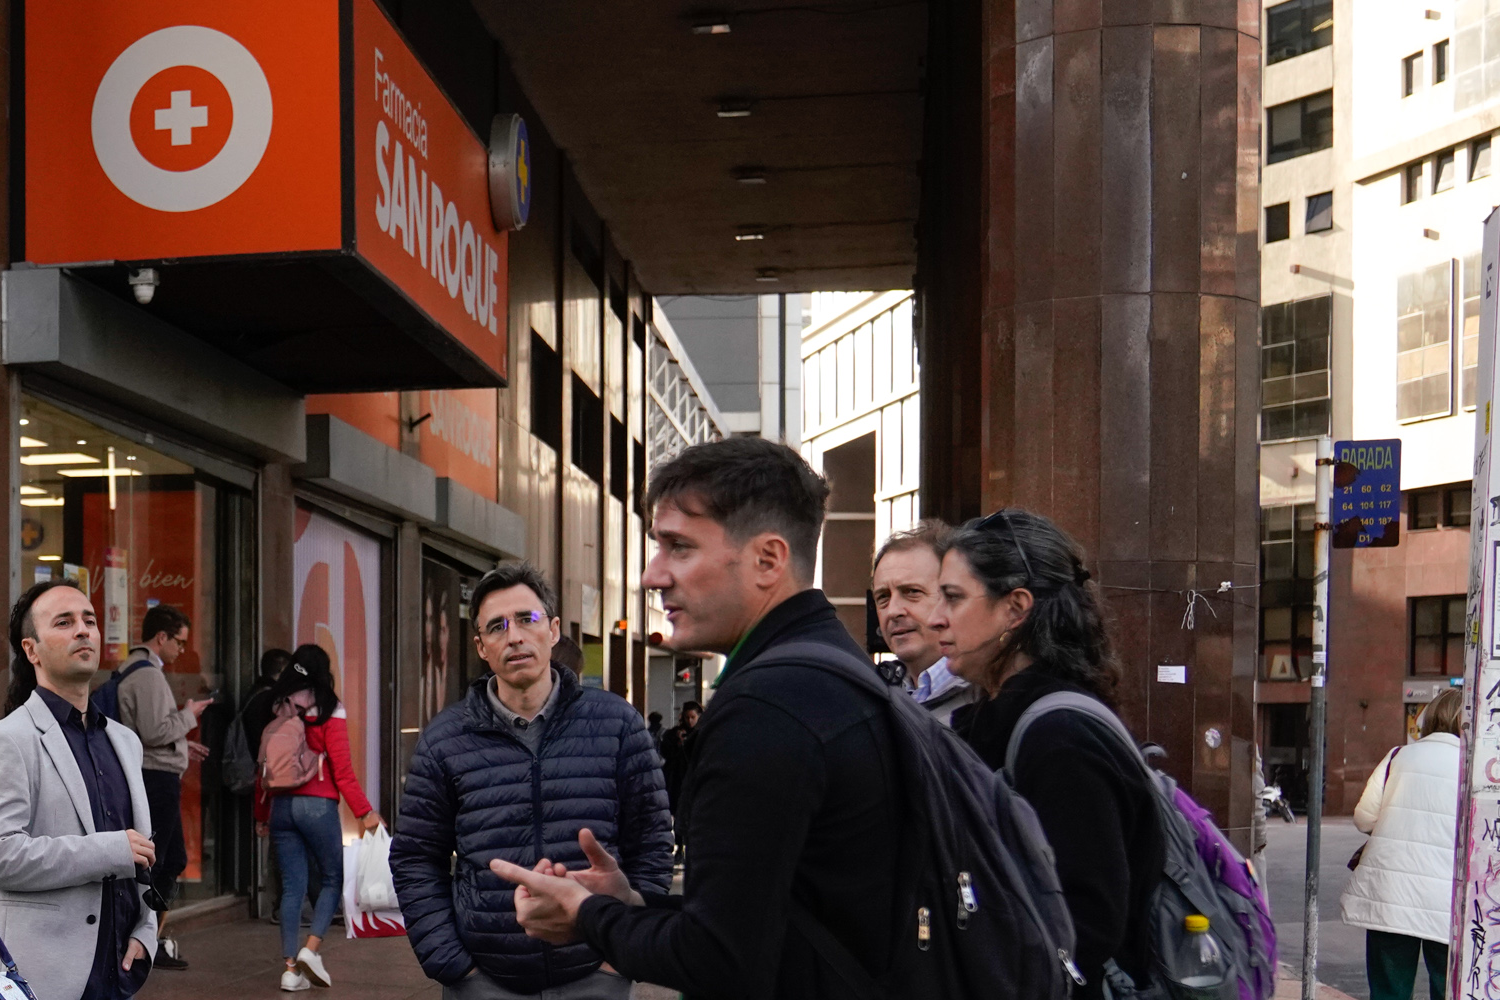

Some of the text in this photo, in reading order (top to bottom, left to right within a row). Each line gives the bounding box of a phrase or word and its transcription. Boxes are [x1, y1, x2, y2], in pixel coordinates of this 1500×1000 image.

[374, 46, 428, 161] Farmacia
[375, 119, 498, 337] SAN ROQUE
[1341, 446, 1393, 470] PARADA
[1343, 484, 1392, 494] 21 60 62
[1342, 500, 1392, 511] 64 104 117
[1360, 517, 1374, 526] 140
[1359, 534, 1370, 543] D1
[139, 557, 194, 590] bien
